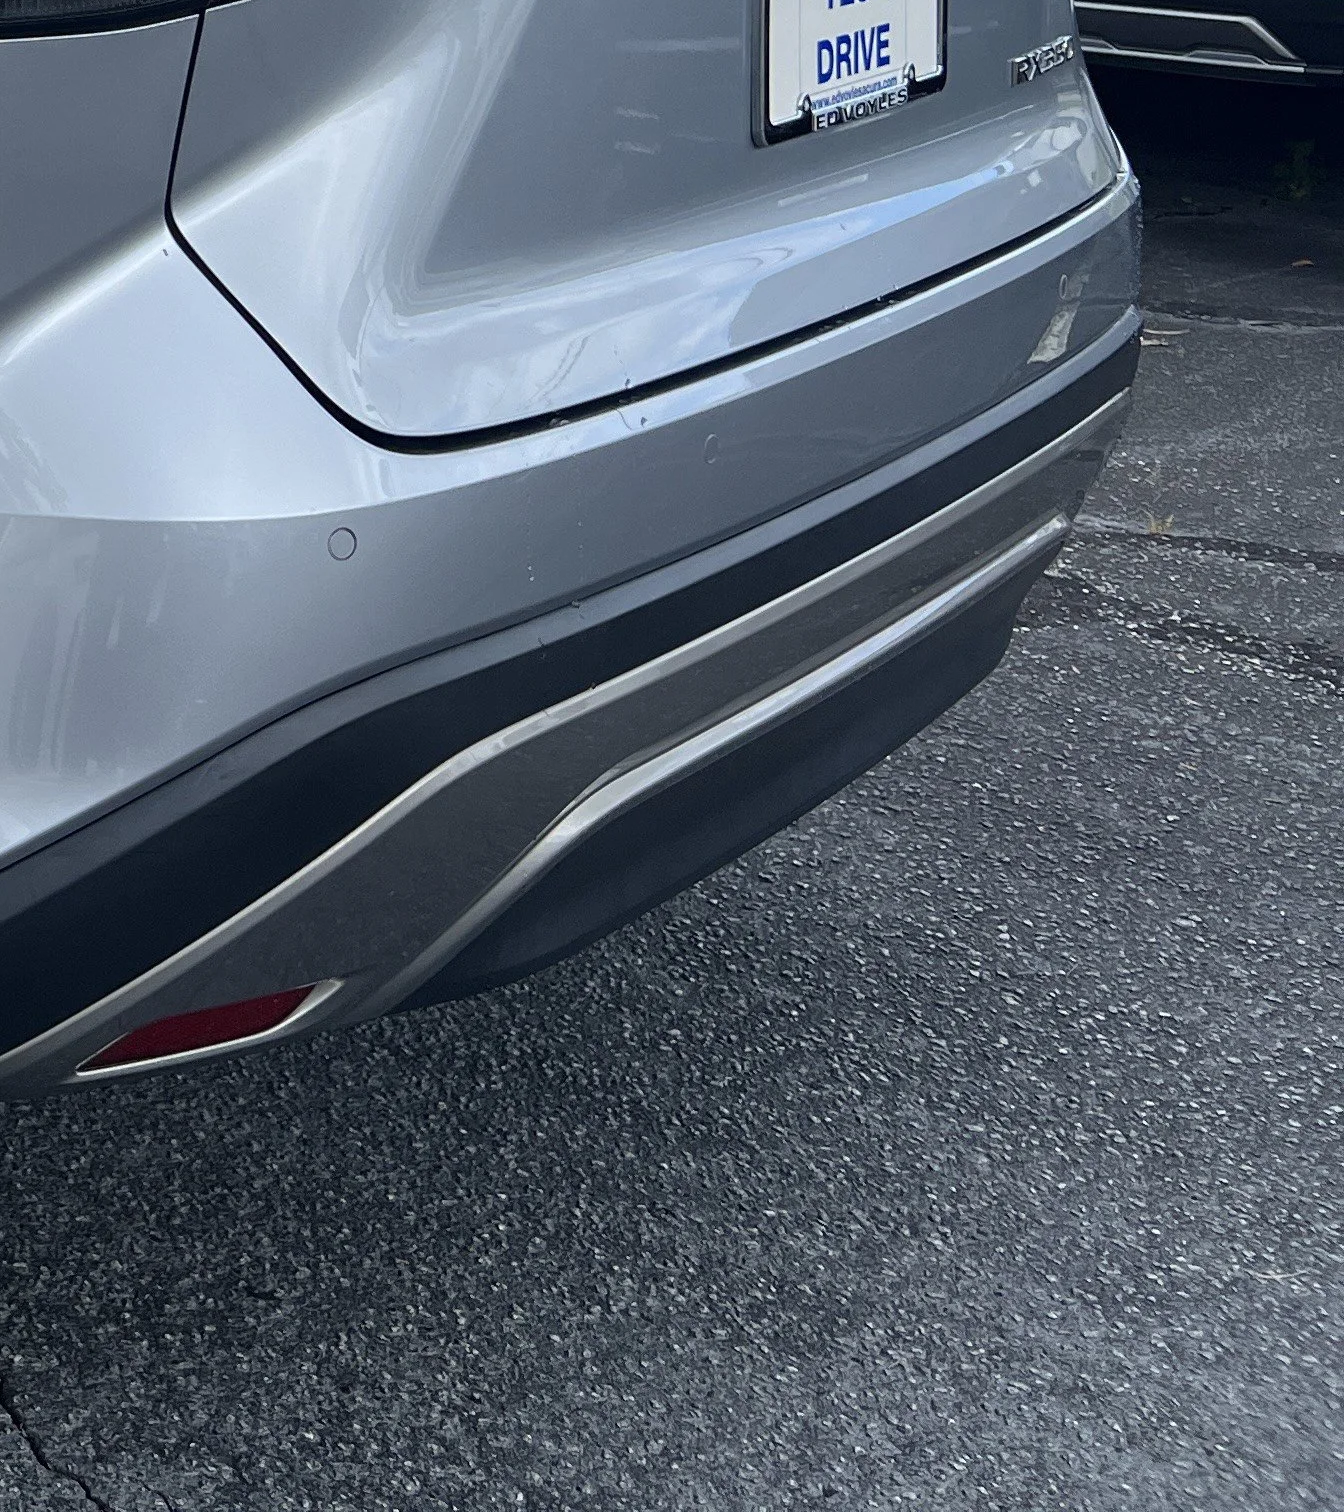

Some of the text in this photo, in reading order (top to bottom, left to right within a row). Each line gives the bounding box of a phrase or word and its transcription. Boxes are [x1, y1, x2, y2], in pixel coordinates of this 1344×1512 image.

[817, 23, 890, 84] DRIVE
[815, 88, 908, 131] ED VOYLES
